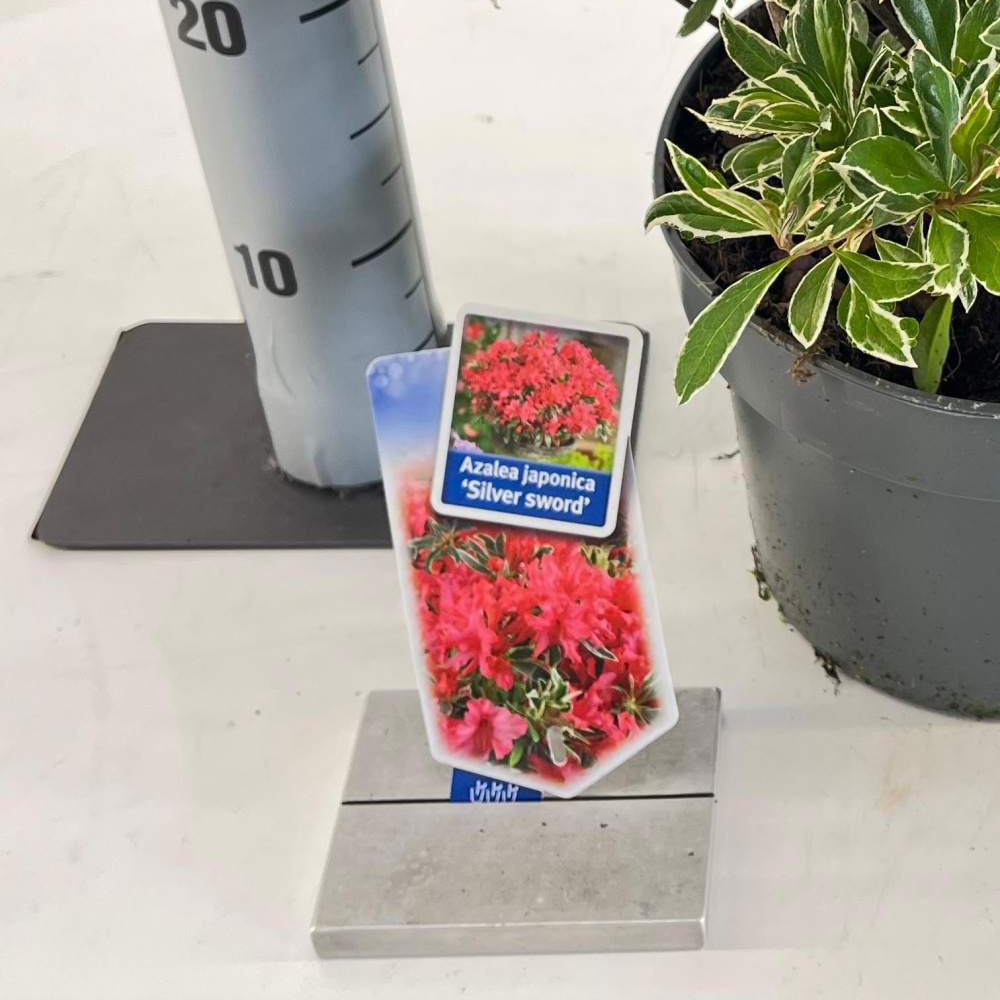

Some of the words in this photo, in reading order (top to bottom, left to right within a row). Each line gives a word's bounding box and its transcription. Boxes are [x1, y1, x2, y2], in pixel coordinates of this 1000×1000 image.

[234, 244, 298, 298] 10
[459, 456, 519, 481] Azalea
[521, 464, 596, 493] japonica
[461, 478, 522, 506] ‘Silver
[524, 492, 591, 515] sword’
